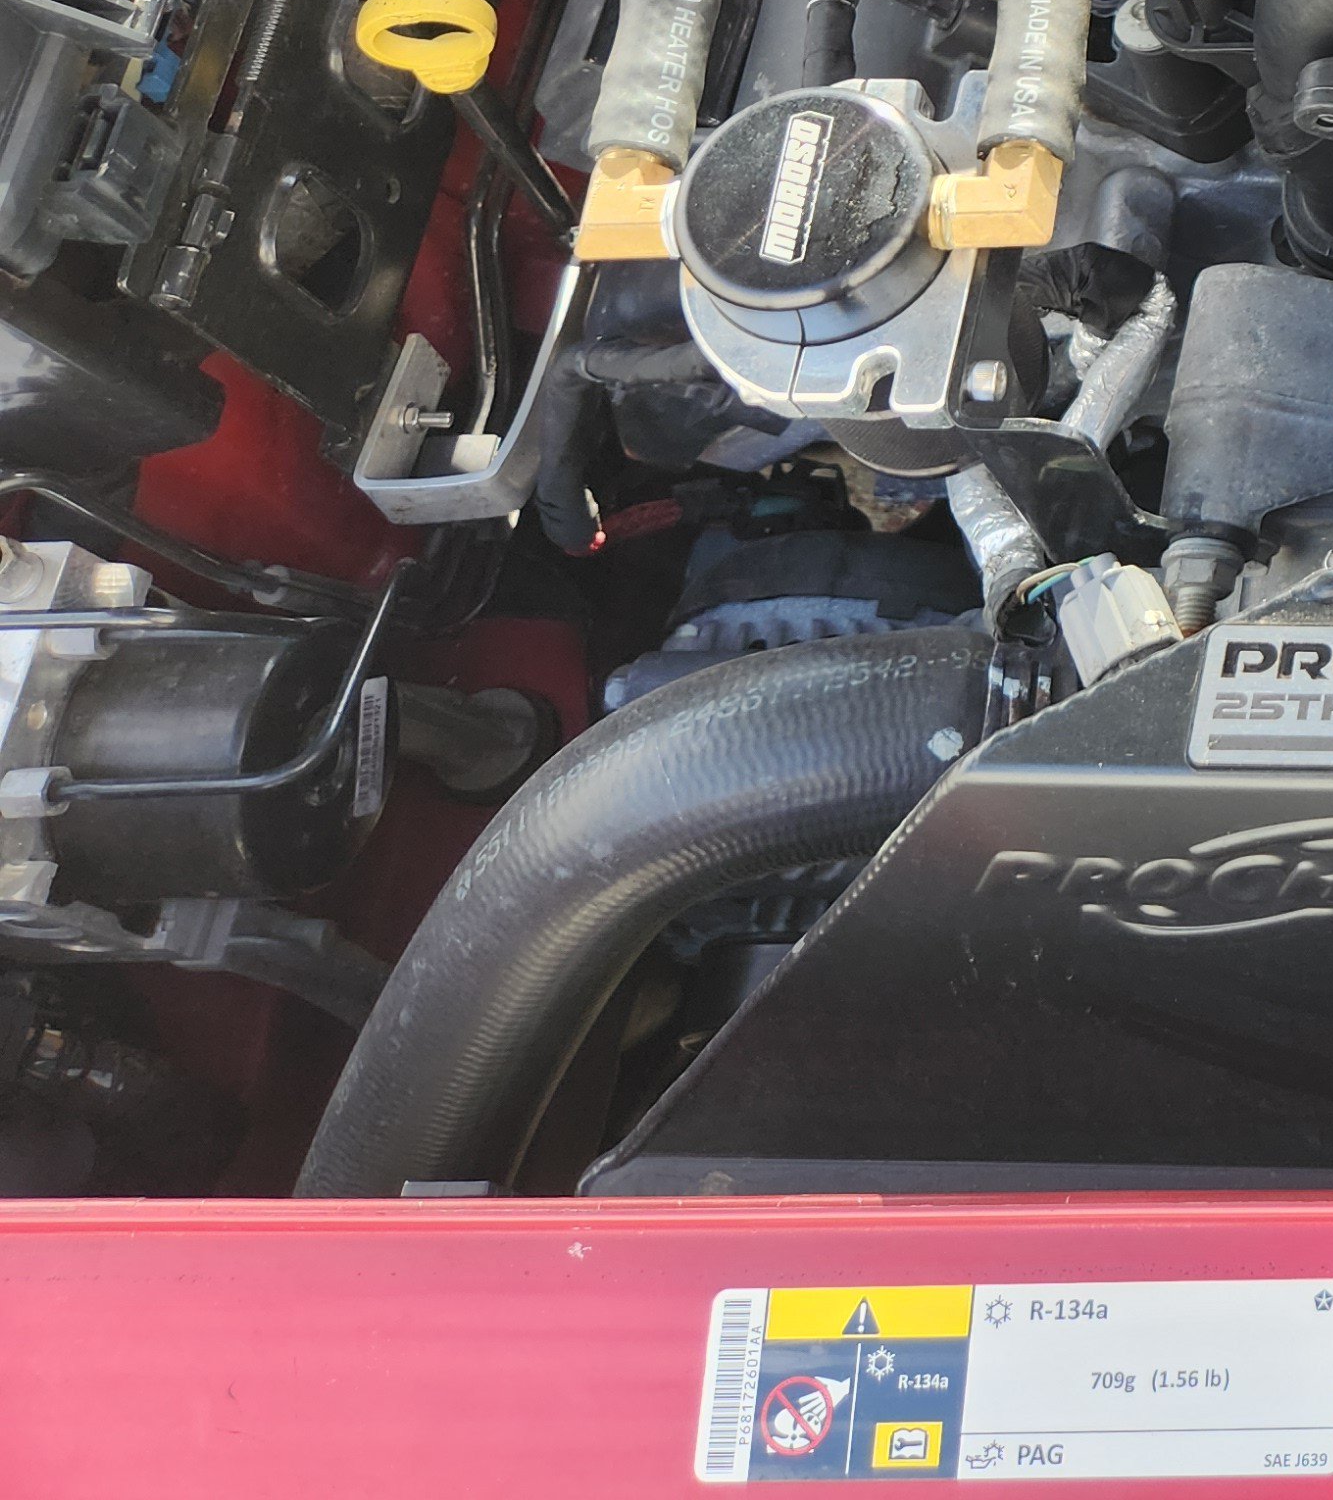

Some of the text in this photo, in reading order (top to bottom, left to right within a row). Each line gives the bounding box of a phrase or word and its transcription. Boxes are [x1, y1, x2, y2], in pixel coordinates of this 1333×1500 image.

[657, 4, 697, 94] HEATER
[1019, 50, 1045, 78] IN
[1009, 78, 1041, 122] USA
[761, 117, 822, 263] MOROSO
[1029, 1298, 1109, 1322] R-134a
[738, 1324, 763, 1446] P68172601AA
[897, 1373, 949, 1391] R-134a
[1090, 1368, 1231, 1393] 709g (1.56 lb)
[1016, 1443, 1065, 1466] PAG
[1263, 1452, 1328, 1468] SAE J639
